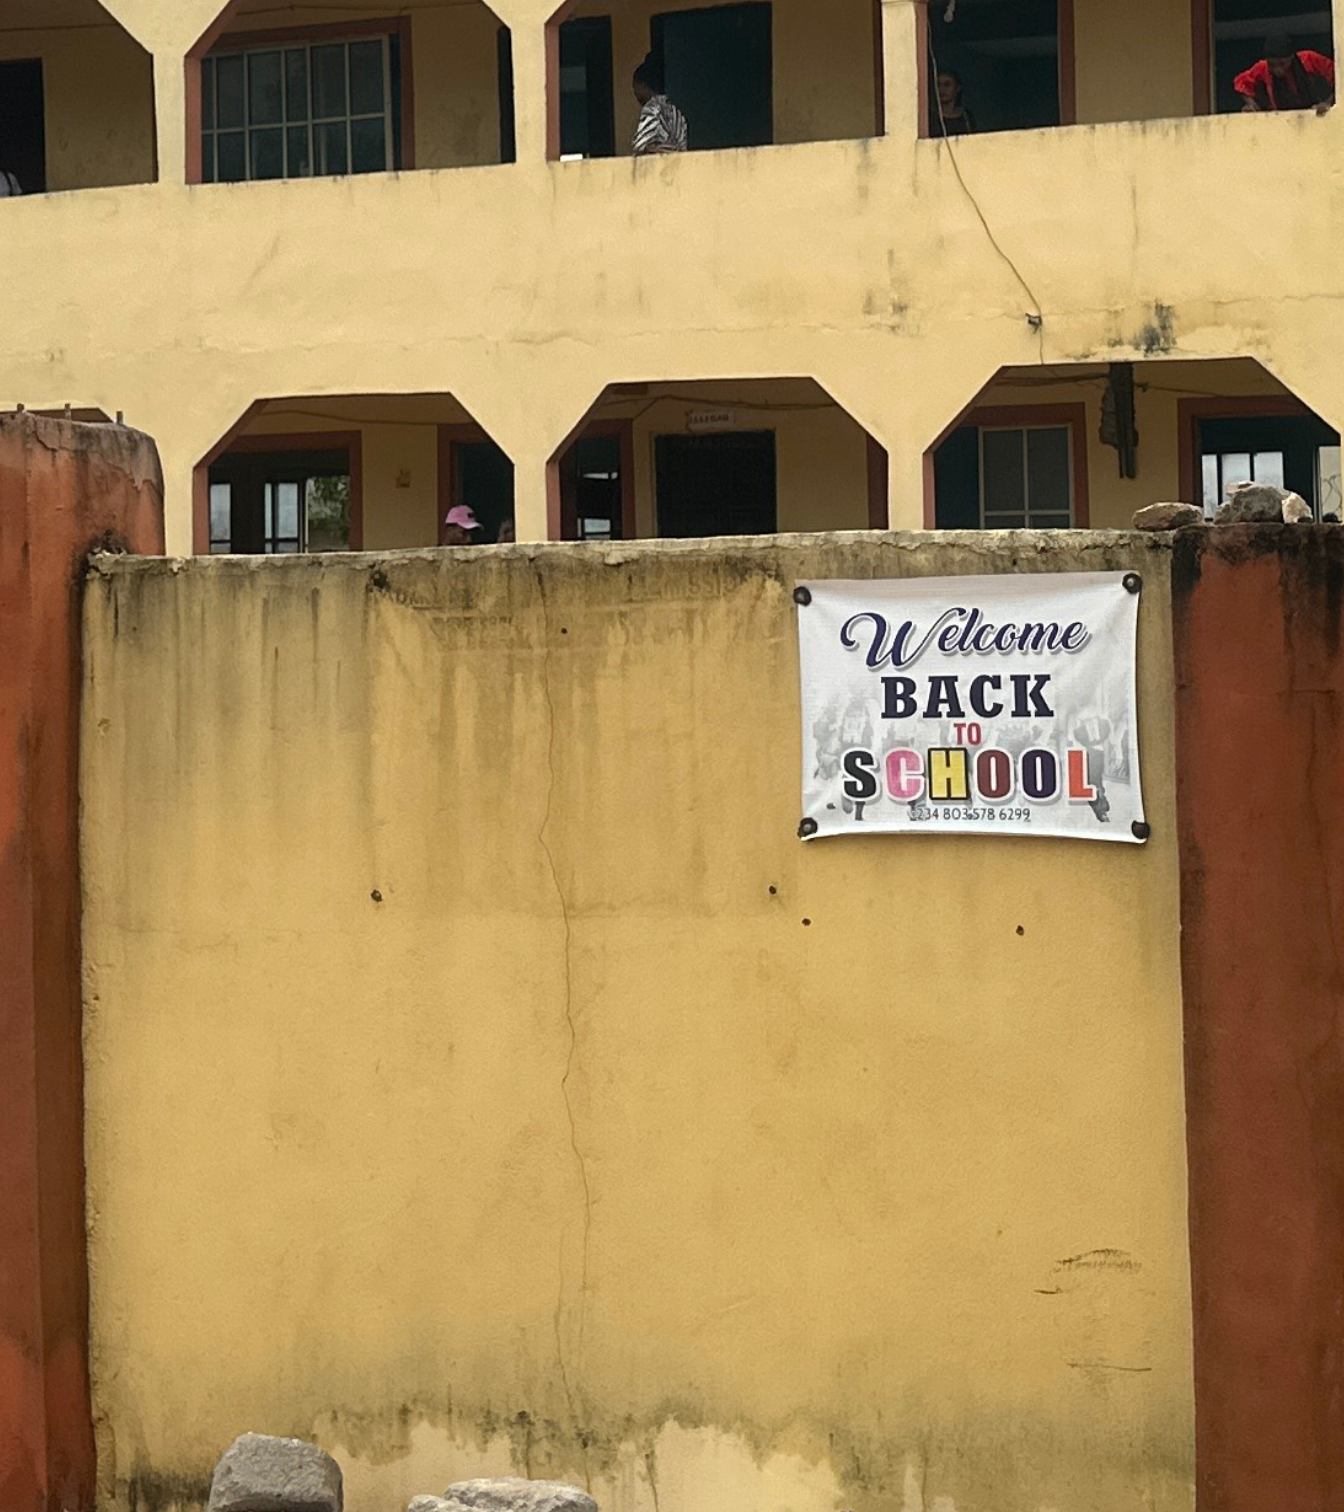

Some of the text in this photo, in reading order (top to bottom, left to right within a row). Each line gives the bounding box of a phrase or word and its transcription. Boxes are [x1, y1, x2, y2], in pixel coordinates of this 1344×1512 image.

[840, 607, 1088, 669] Welcome
[881, 674, 1054, 719] BACK
[953, 722, 982, 745] TO
[842, 747, 1096, 801] SCHOOL
[943, 808, 968, 821] 803
[972, 808, 995, 821] 578
[999, 808, 1031, 822] 6299
